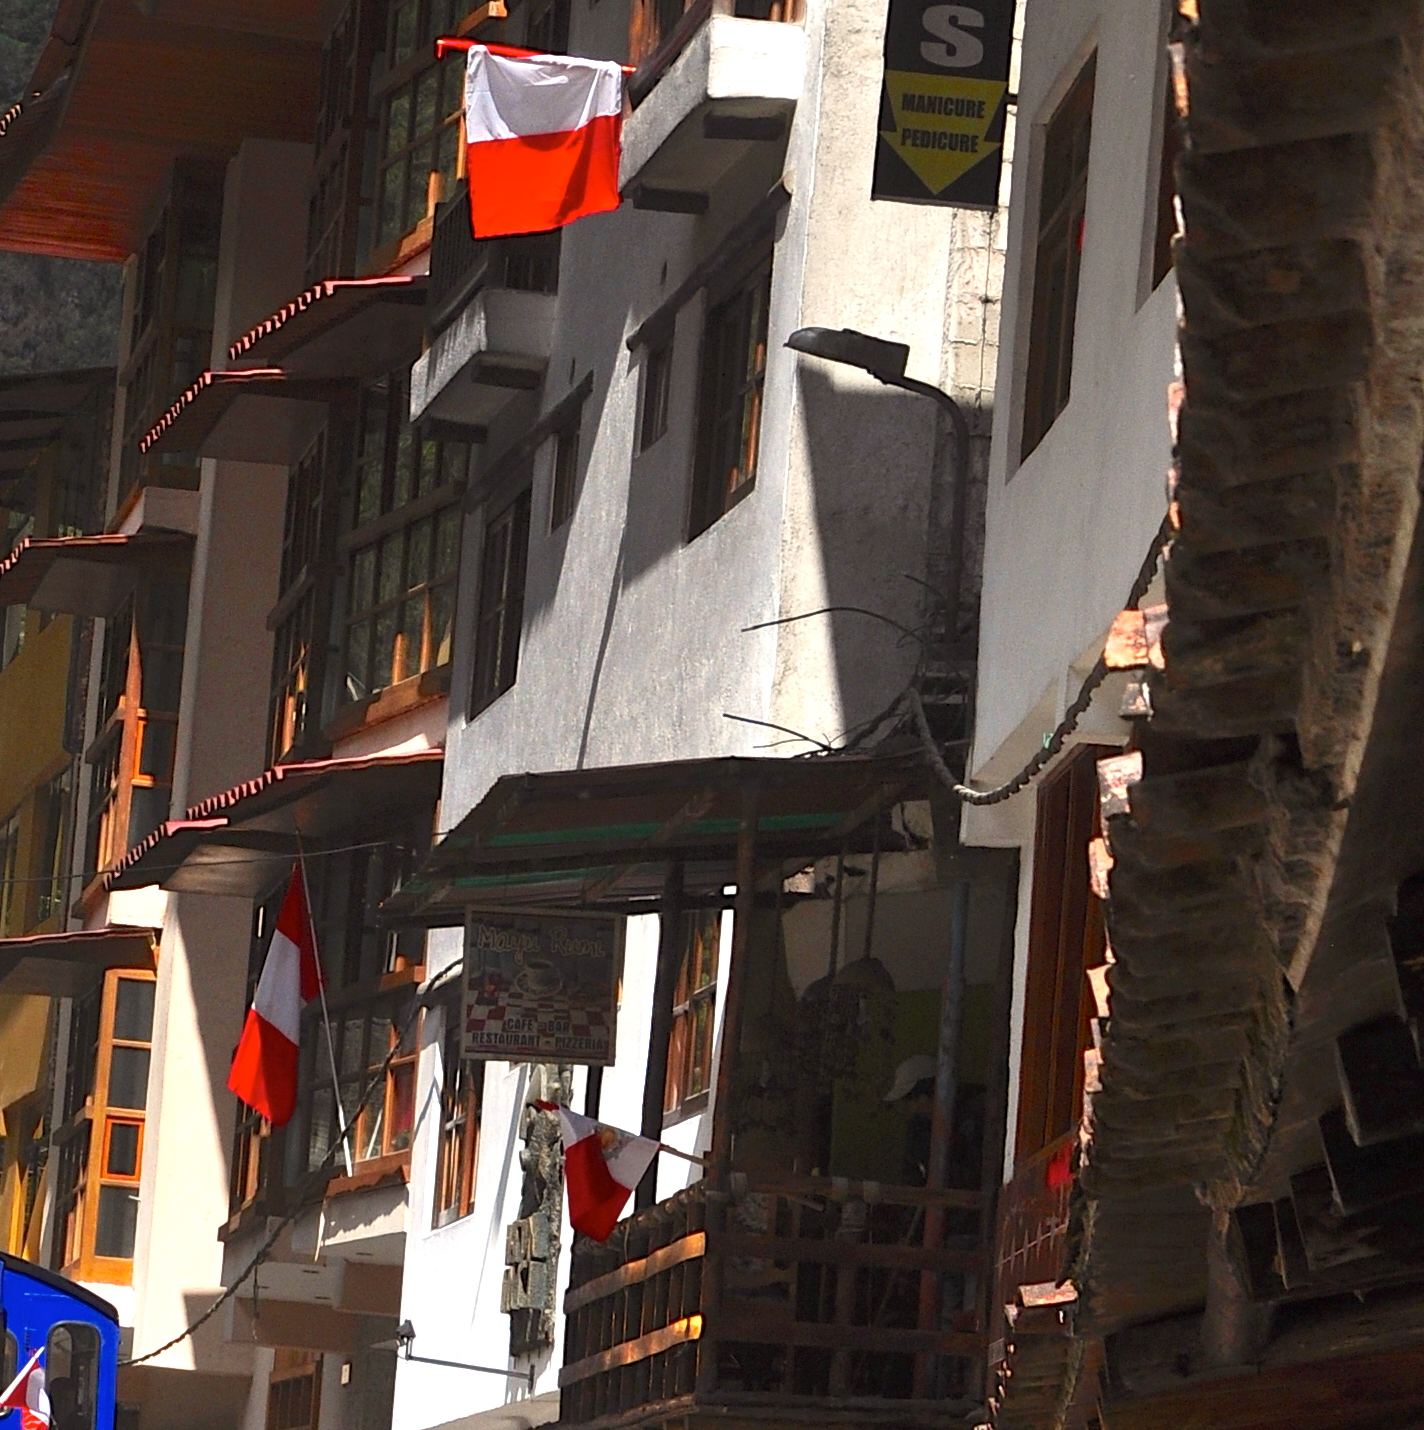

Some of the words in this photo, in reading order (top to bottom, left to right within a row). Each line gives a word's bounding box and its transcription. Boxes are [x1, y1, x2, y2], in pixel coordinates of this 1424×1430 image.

[900, 92, 986, 119] MANICURE
[900, 127, 979, 153] PEDICURE
[477, 924, 541, 965] Mayu
[507, 1018, 533, 1031] CAFE
[547, 1020, 571, 1032] BAR
[472, 1033, 541, 1047] RESTAURANT
[555, 1036, 604, 1050] PIZZERIA
